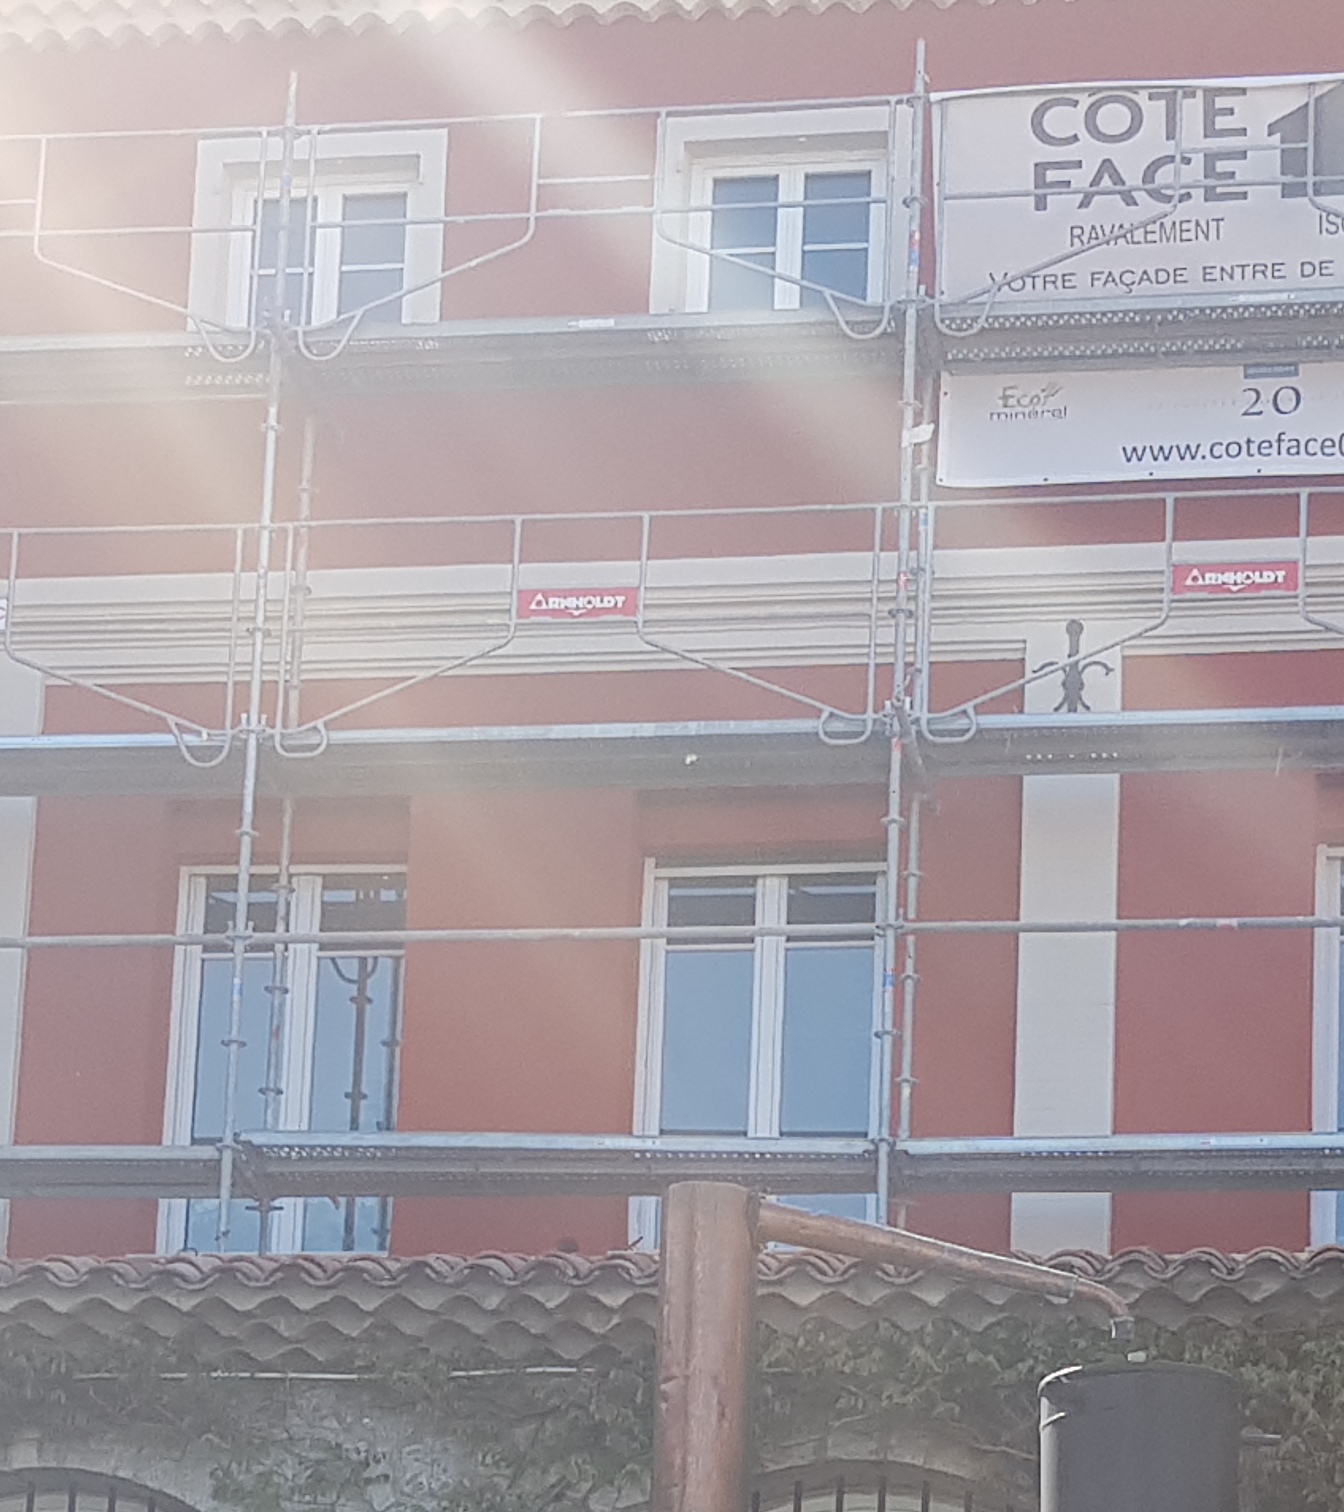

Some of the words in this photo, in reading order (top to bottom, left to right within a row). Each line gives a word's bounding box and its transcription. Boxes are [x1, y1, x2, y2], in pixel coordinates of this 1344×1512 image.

[1033, 149, 1249, 212] FACE
[1069, 217, 1225, 248] RAVALEMENT
[988, 271, 1077, 293] VOTRE
[1090, 267, 1188, 294] FAÇADE
[1202, 262, 1287, 283] ENTRE
[1300, 260, 1335, 279] DE
